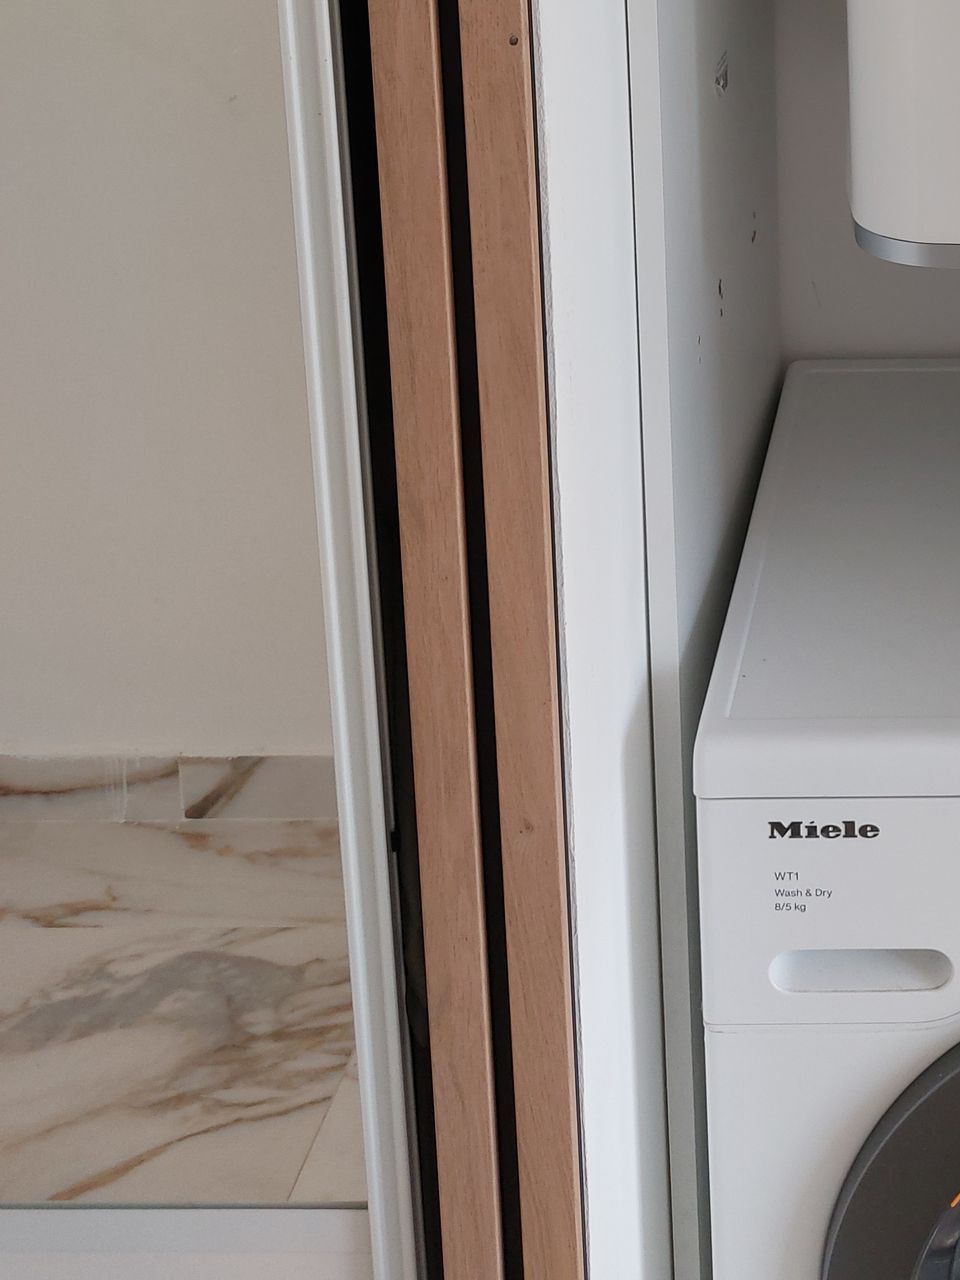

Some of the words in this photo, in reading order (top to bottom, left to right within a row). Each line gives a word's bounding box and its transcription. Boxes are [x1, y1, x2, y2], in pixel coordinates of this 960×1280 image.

[768, 820, 880, 839] Miele
[774, 871, 799, 881] WT1
[774, 888, 803, 897] Wash
[805, 888, 813, 897] &
[815, 888, 833, 899] Dry
[774, 902, 792, 911] 8/5
[794, 902, 807, 913] kg
